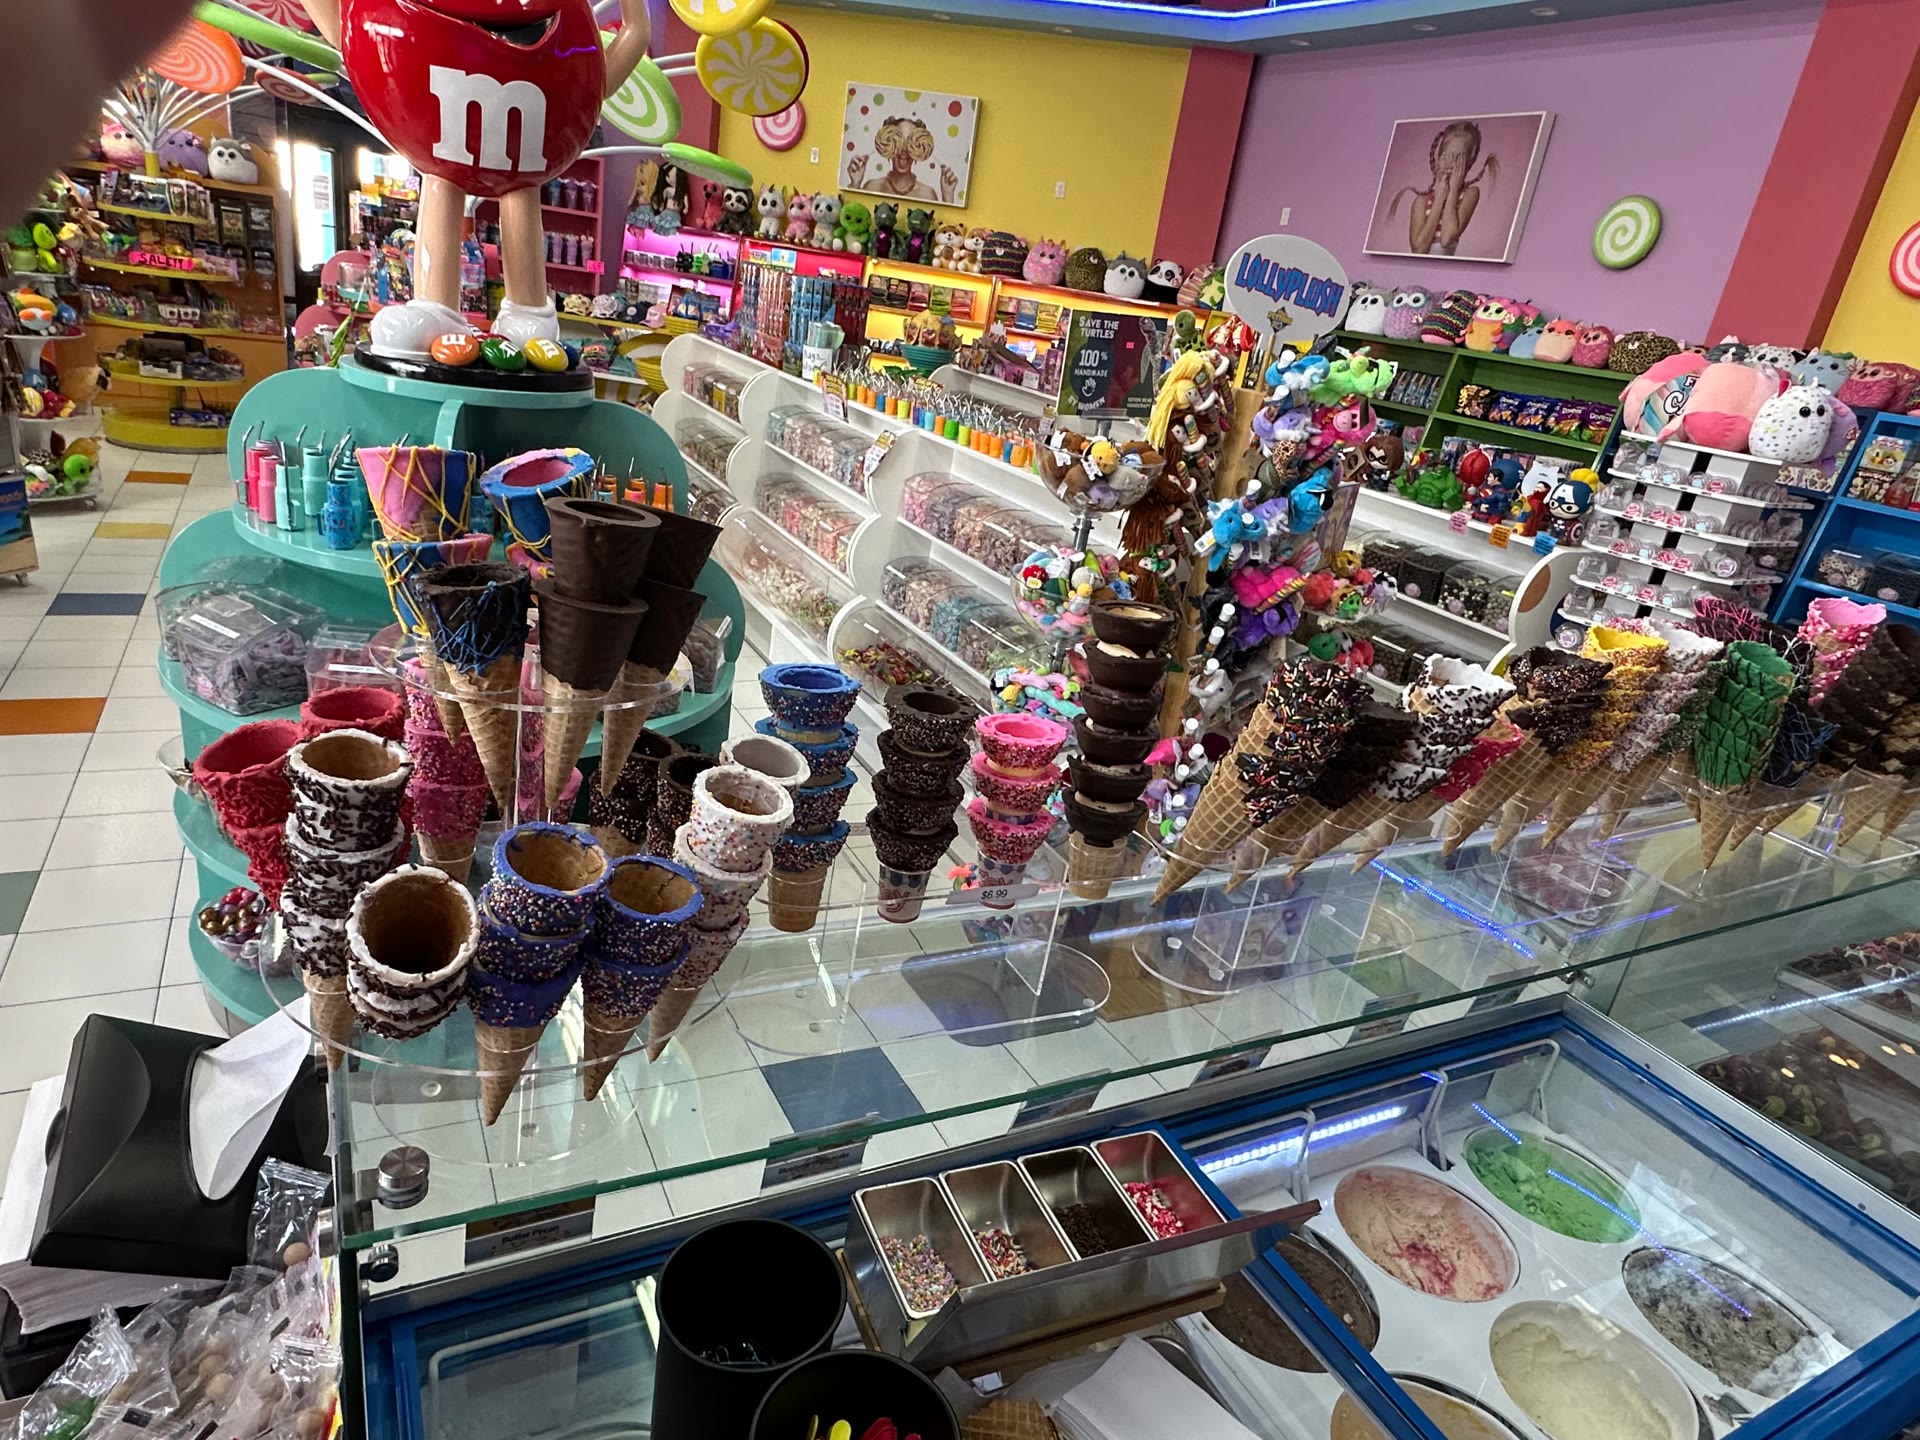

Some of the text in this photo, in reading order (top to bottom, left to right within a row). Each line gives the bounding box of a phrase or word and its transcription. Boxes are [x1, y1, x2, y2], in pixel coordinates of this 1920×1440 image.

[429, 64, 548, 172] m
[1234, 252, 1345, 318] LOLLYPLUSH
[1078, 316, 1119, 330] SAVE THE
[1080, 327, 1115, 339] TURTLES
[1074, 368, 1108, 378] HANDMADE
[980, 888, 1008, 900] $6.99
[501, 1231, 531, 1245] Butter
